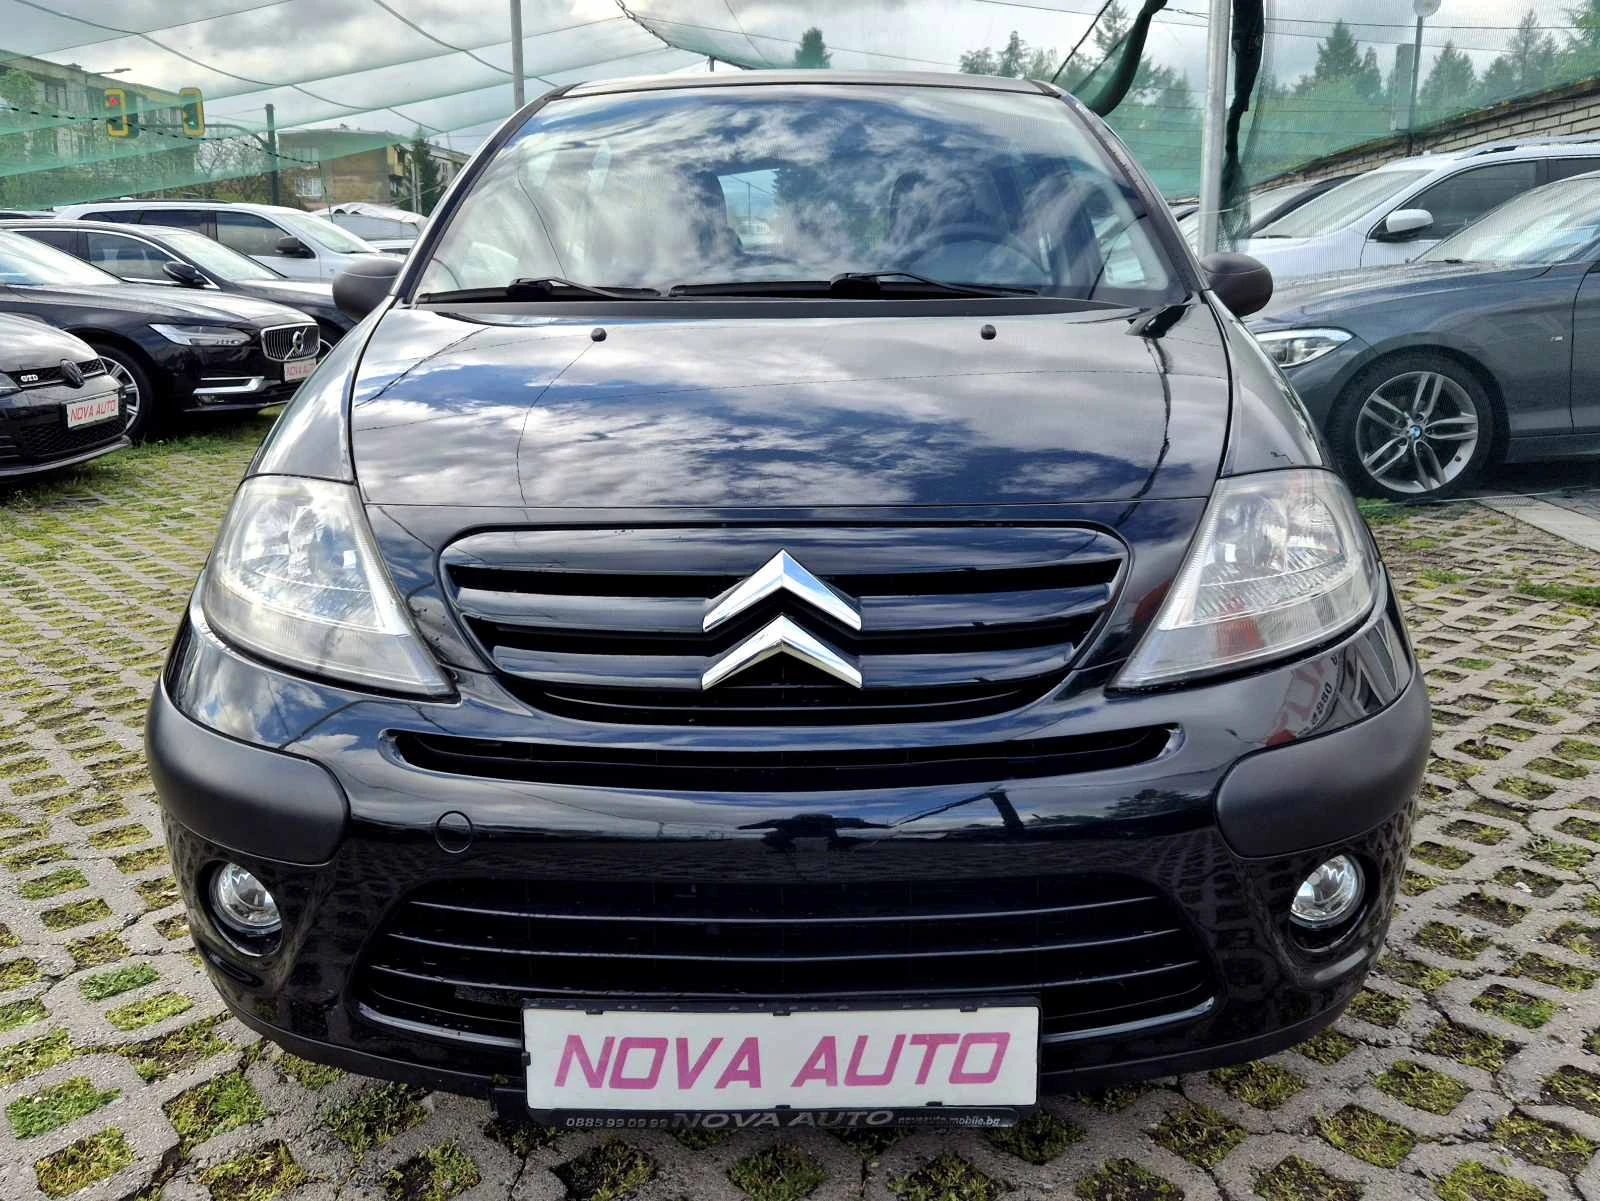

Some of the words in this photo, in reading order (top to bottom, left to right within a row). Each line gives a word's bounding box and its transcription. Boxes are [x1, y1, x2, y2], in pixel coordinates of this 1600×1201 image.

[71, 404, 94, 421] NOVA
[95, 399, 116, 416] AUTO
[554, 1034, 761, 1090] NOVA
[790, 1032, 1011, 1087] AUTO
[565, 1117, 602, 1128] 0885
[671, 1112, 780, 1129] NOVA
[788, 1110, 894, 1128] AUTO
